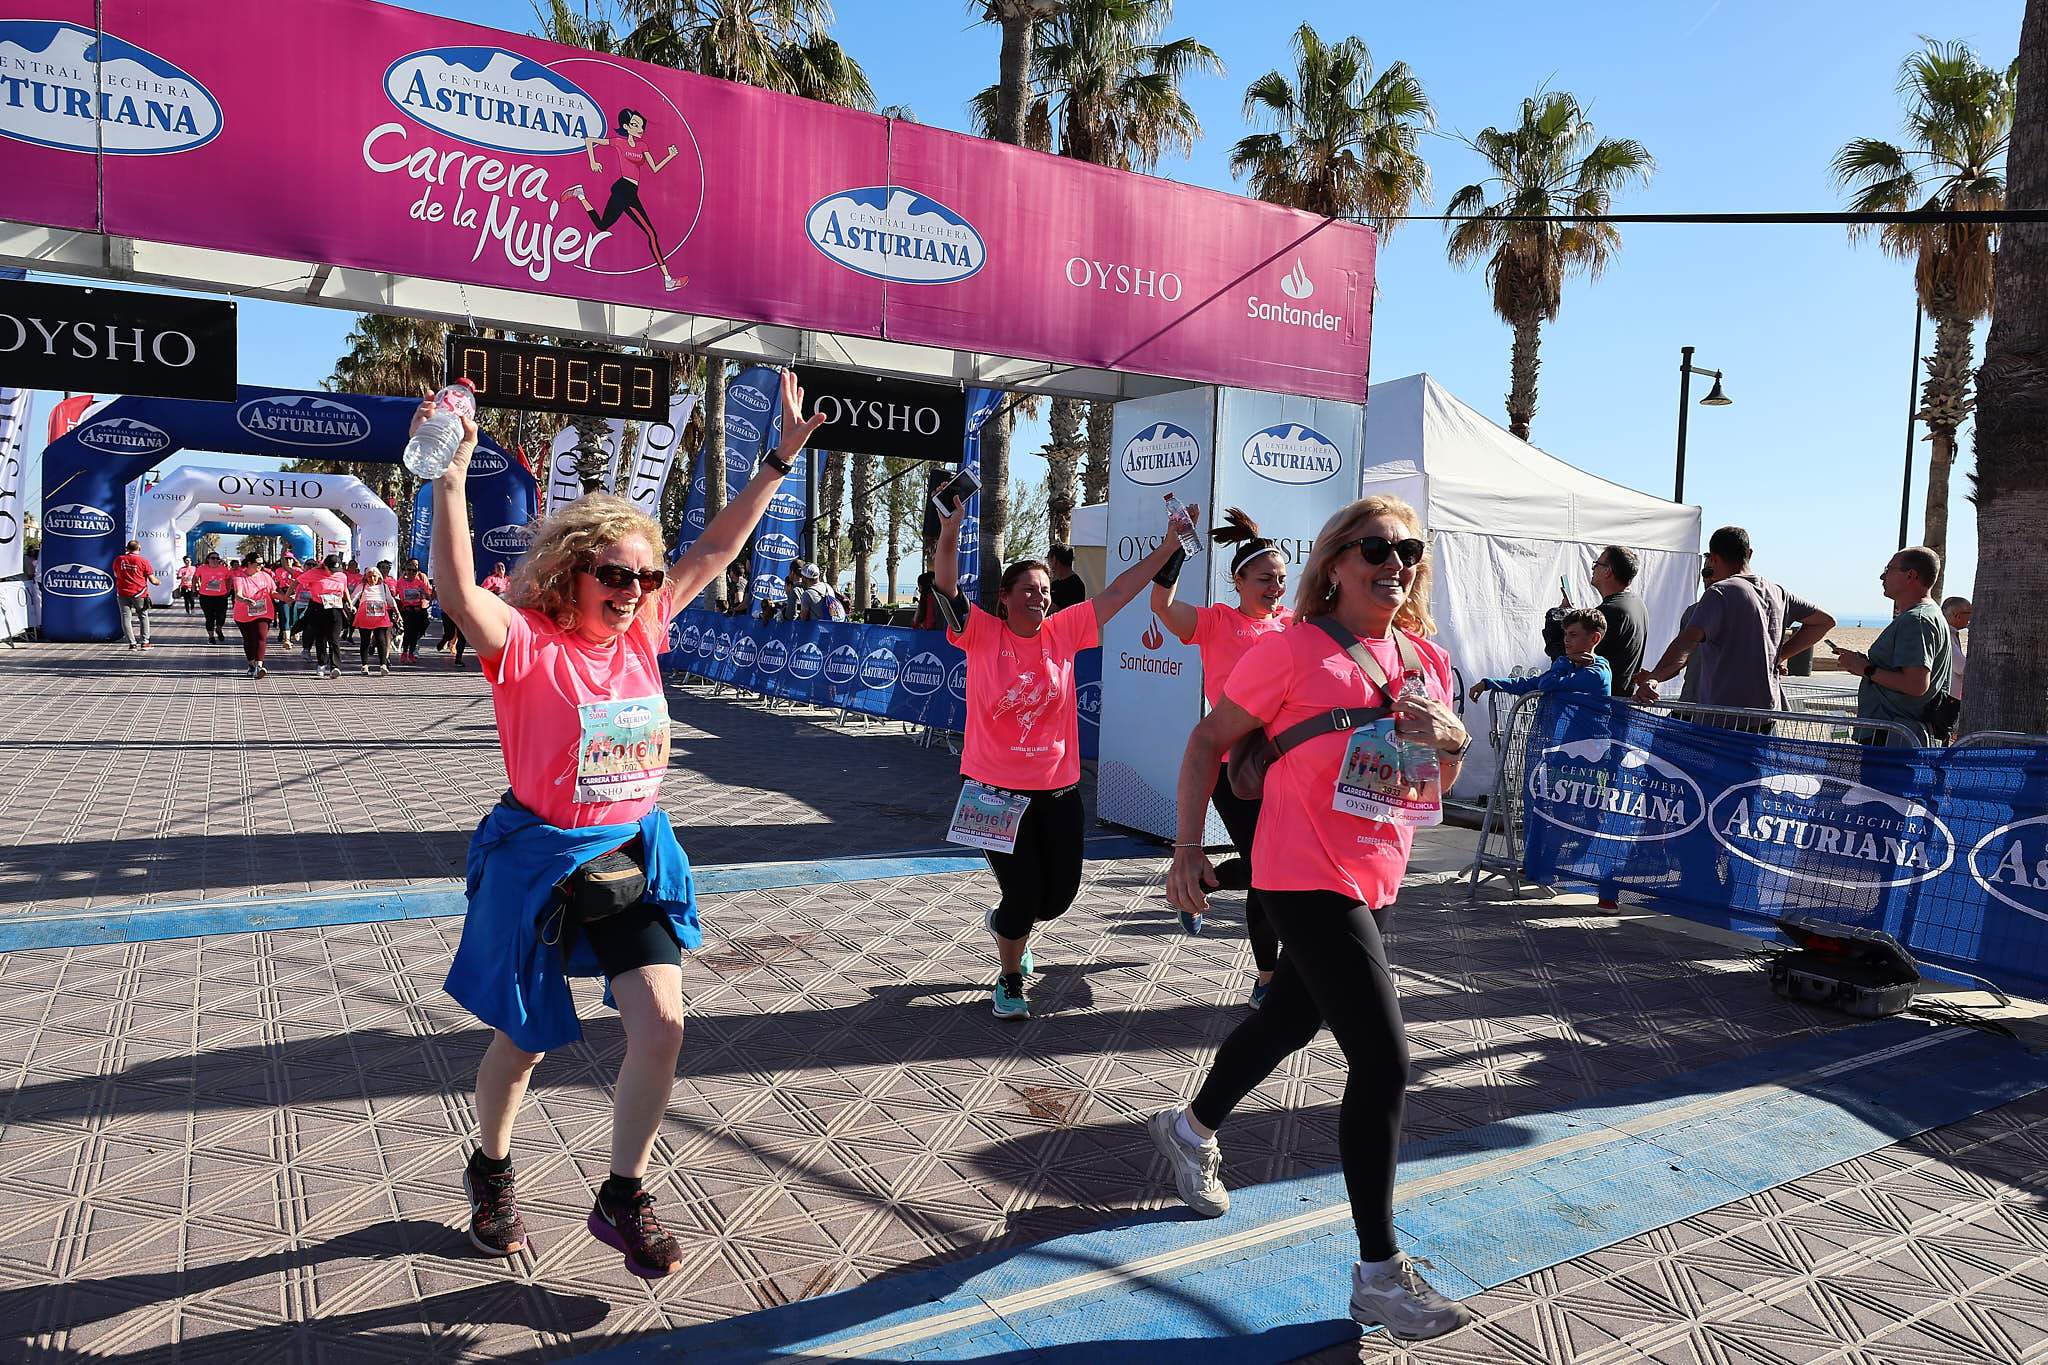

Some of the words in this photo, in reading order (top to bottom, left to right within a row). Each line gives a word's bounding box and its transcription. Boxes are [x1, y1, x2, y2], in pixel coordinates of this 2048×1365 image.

[0, 56, 82, 80] ENTRAL
[0, 74, 201, 136] TURIANA
[402, 68, 590, 139] ASTURIANA
[438, 71, 510, 95] CENTRAL
[516, 88, 585, 110] LECHERA
[362, 122, 550, 201] Carrera
[409, 186, 445, 223] de
[453, 190, 479, 230] la
[471, 195, 613, 282] Mujer
[820, 209, 973, 268] ASTURIANA
[850, 211, 907, 230] CENTRAL
[912, 223, 968, 240] LECHERA
[1065, 257, 1183, 301] OYSHO
[1247, 296, 1342, 331] Santander
[0, 313, 196, 367] OYSHO
[248, 407, 361, 437] ASTURIANA
[268, 407, 311, 418] CENTRAL
[315, 410, 357, 420] LECHERA
[813, 395, 941, 435] OYSHO
[83, 429, 163, 449] ASTURIANA
[469, 459, 504, 469] RIANA
[632, 422, 676, 505] SHO
[1126, 449, 1193, 472] ASTURIANA
[1249, 442, 1334, 472] ASTURIANA
[153, 493, 186, 502] OYSHO
[218, 475, 323, 499] OYSHO
[46, 515, 110, 531] ASTURIANA
[415, 506, 430, 547] Marlene
[46, 574, 109, 590] ASTURIANA
[861, 663, 897, 681] ASTURIANA
[903, 665, 941, 686] ASTURIANA
[1120, 651, 1184, 677] Santander
[612, 741, 647, 760] 016
[1342, 785, 1370, 799] CARRERA
[1537, 761, 1687, 825] ASTURIANA
[1560, 765, 1618, 782] CENTRAL
[1623, 774, 1685, 795] LECHERA
[1346, 799, 1379, 814] OYSHO
[1763, 799, 1836, 821] CENTRAL
[1844, 815, 1930, 836] LECHERA
[1721, 797, 1931, 870] ASTURIANA
